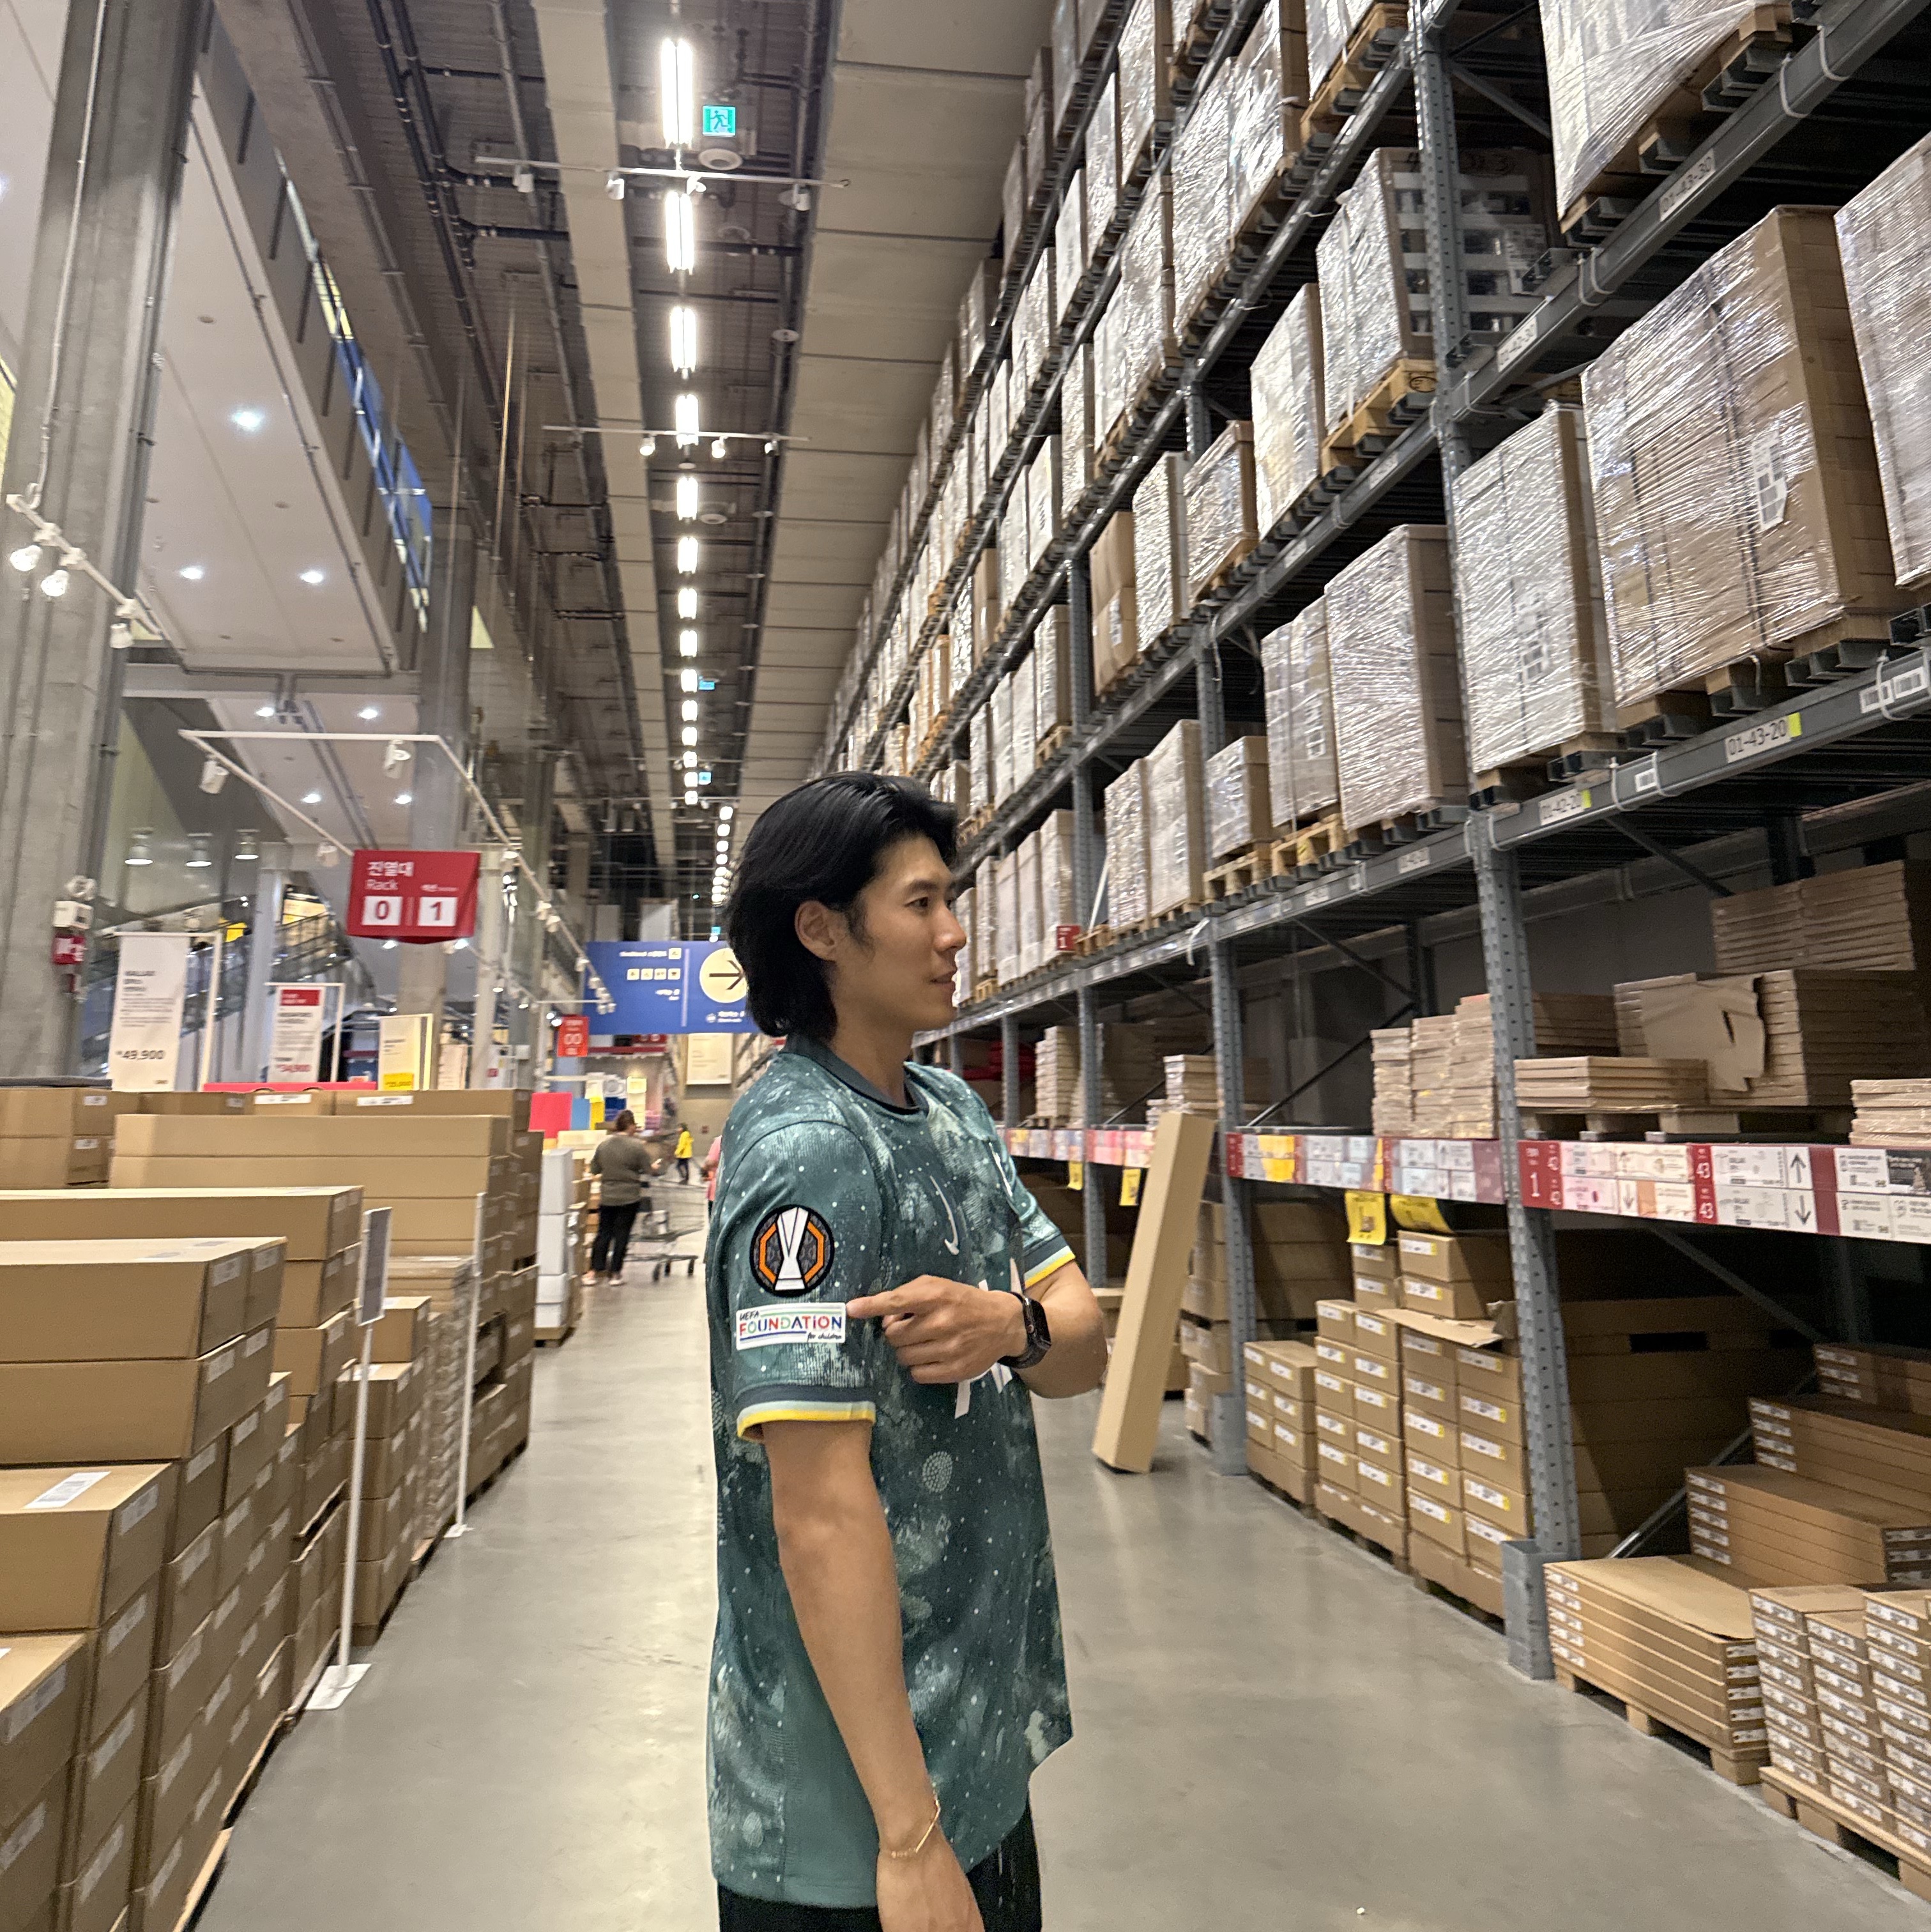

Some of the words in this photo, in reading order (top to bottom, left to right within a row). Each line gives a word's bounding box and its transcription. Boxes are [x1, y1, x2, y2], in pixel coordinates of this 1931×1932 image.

[1728, 719, 1787, 755] 01-43-20
[367, 861, 414, 877] 진열대
[365, 879, 399, 890] Rack
[375, 900, 390, 920] 0
[430, 901, 443, 921] 1
[1696, 1162, 1711, 1179] 43
[1529, 1172, 1540, 1198] 1
[1699, 1202, 1714, 1220] 43
[739, 1310, 759, 1321] UEFA
[807, 1331, 816, 1342] for
